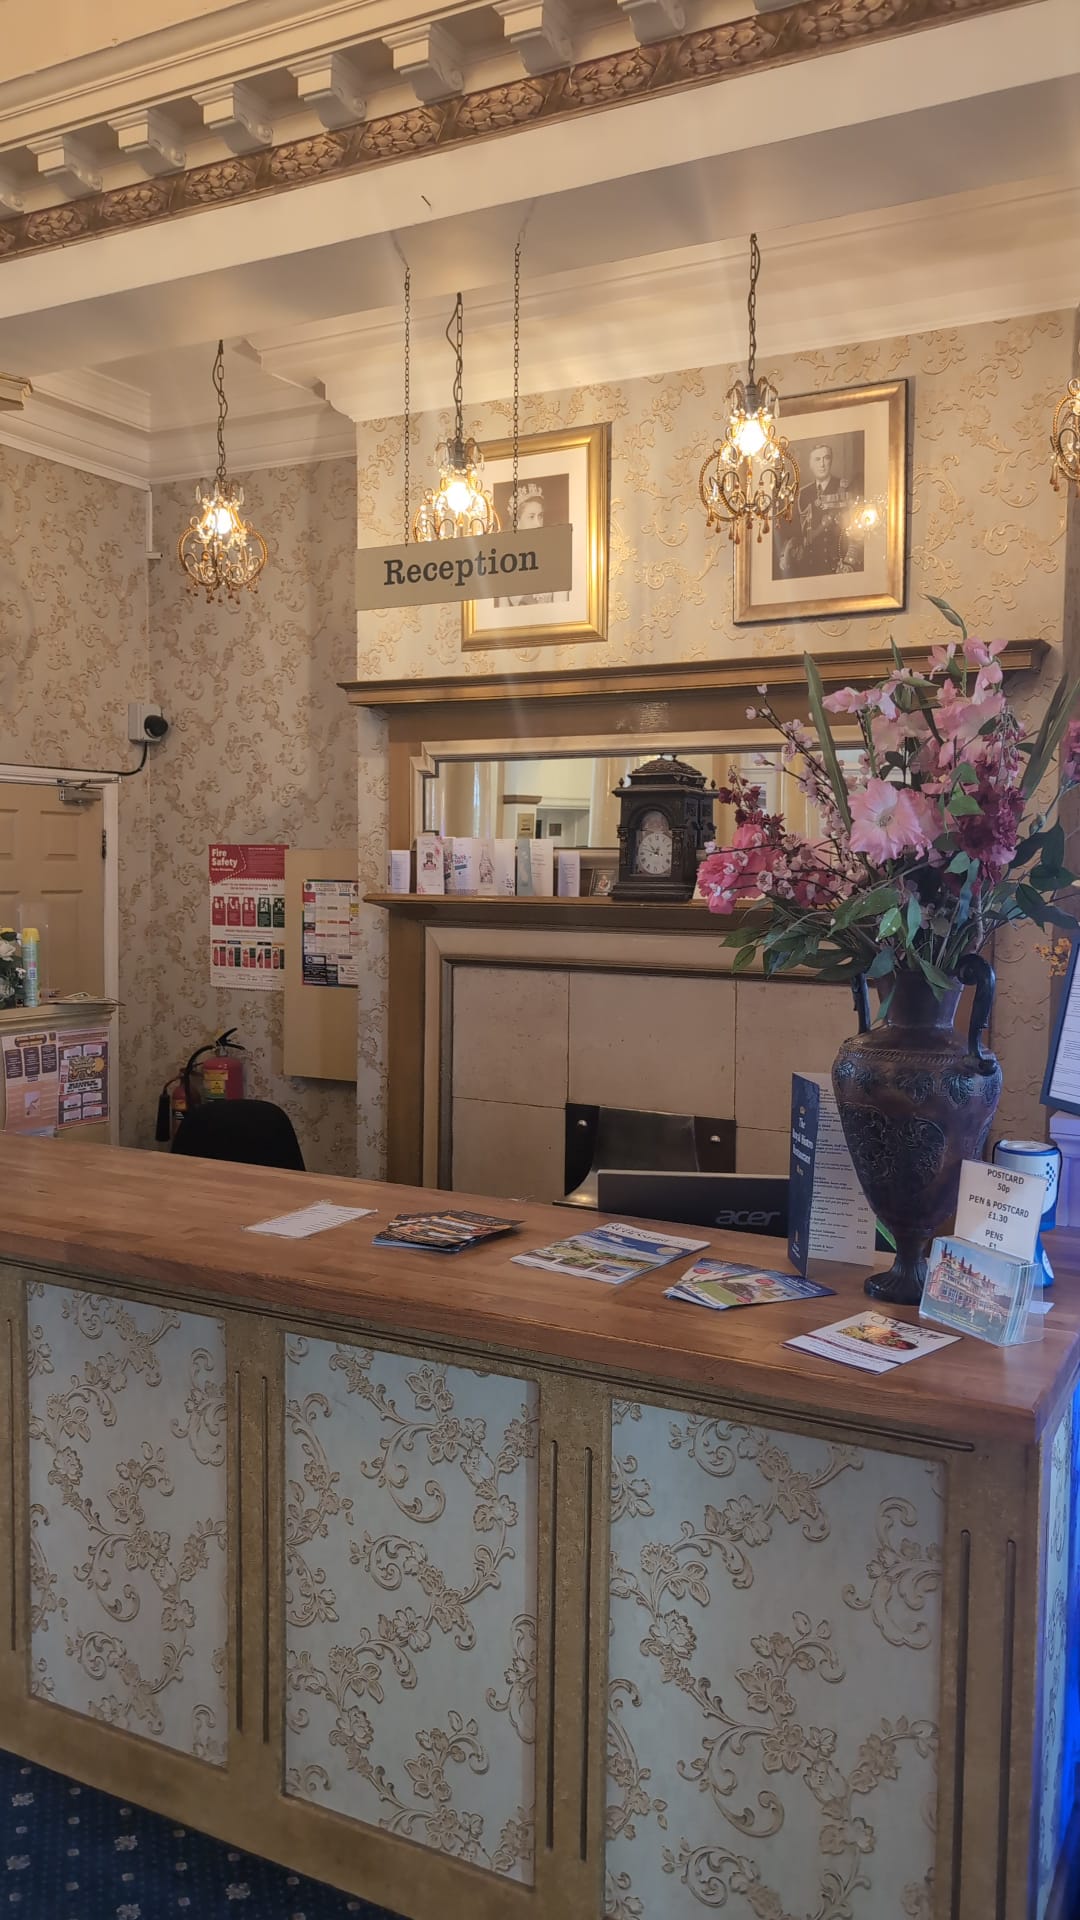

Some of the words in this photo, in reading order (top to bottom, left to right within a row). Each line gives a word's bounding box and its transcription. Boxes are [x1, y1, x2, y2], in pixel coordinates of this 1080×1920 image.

[383, 548, 539, 586] Reception
[211, 848, 227, 857] Fire
[211, 857, 238, 868] Safety
[987, 1168, 1024, 1185] POSTCARD
[997, 1182, 1010, 1194] 50p
[968, 1194, 985, 1205] PEN
[986, 1199, 991, 1207] &
[992, 1201, 1029, 1218] POSTCARD
[715, 1210, 781, 1226] acer
[987, 1211, 1008, 1224] £1.30
[985, 1229, 1004, 1241] PENS
